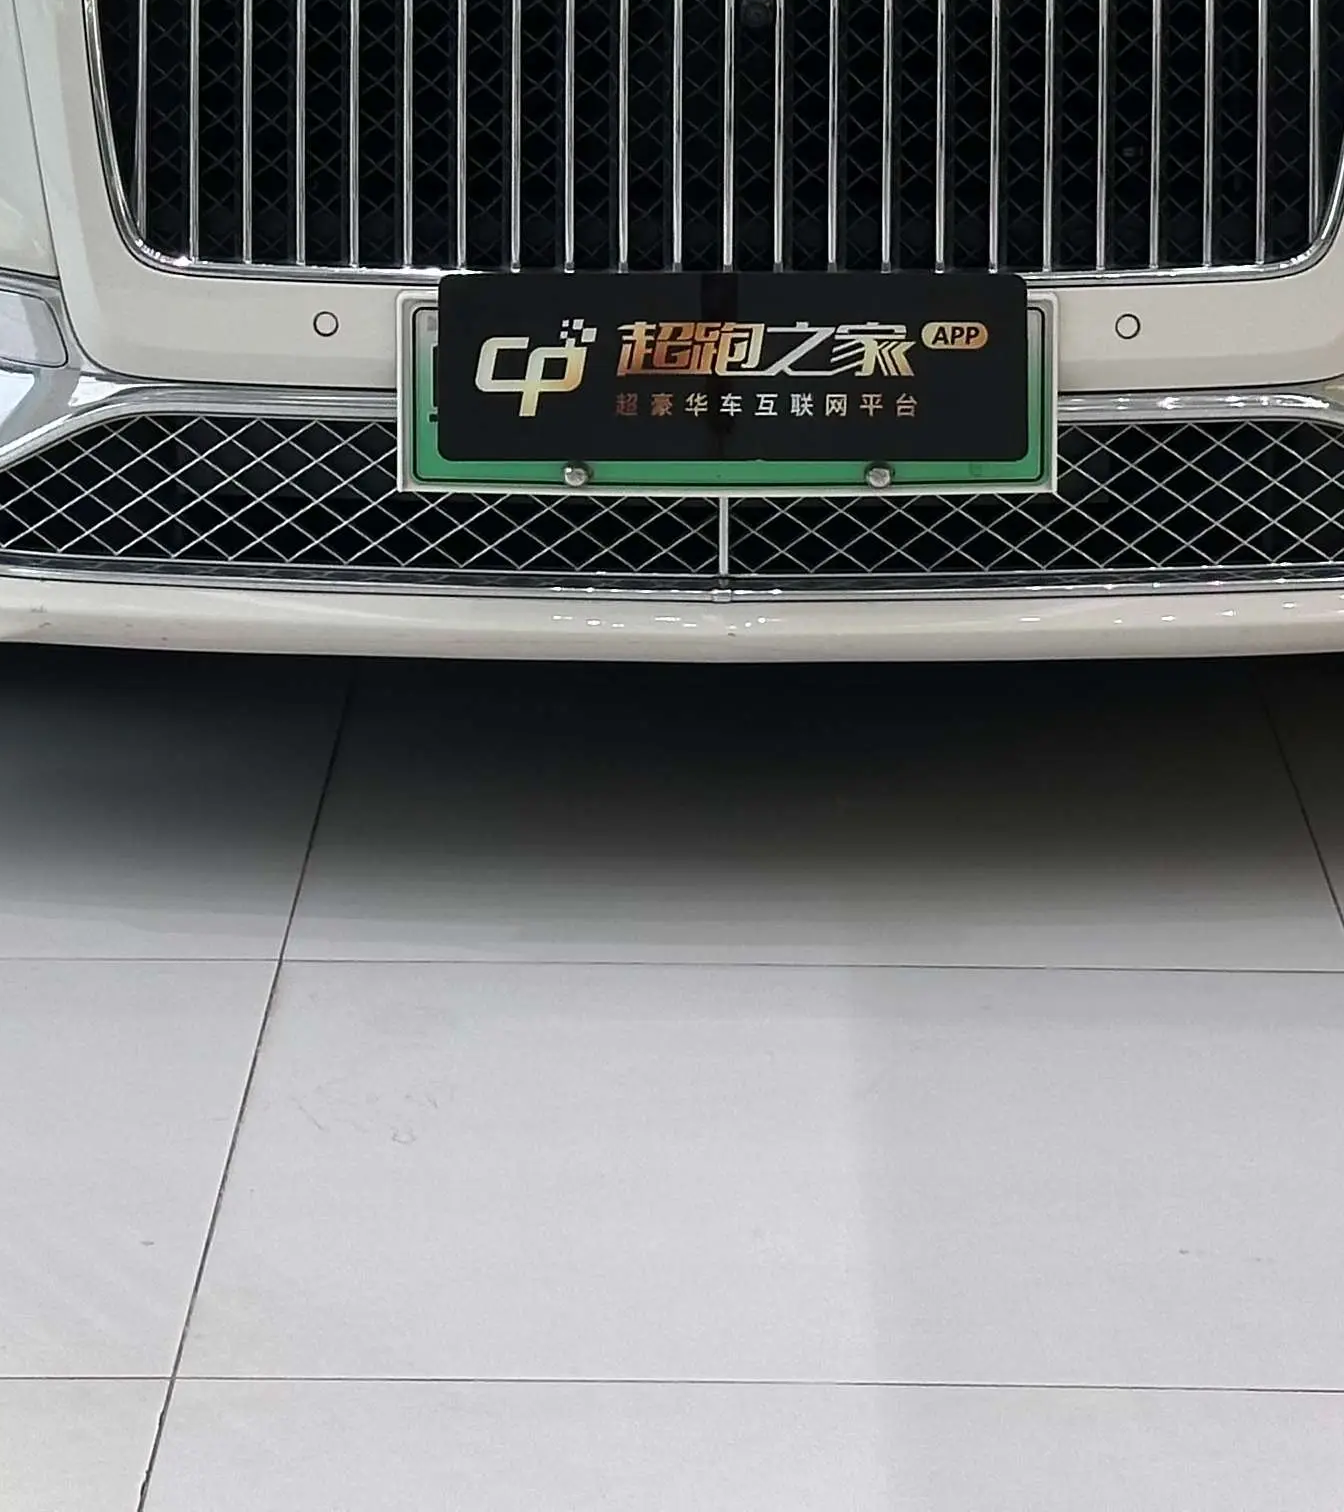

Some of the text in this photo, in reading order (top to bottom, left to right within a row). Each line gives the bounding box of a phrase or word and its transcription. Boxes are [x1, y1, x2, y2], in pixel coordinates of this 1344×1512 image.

[616, 321, 980, 376] 超跑之家 APP
[614, 391, 919, 418] 超豪华车互联网平台
